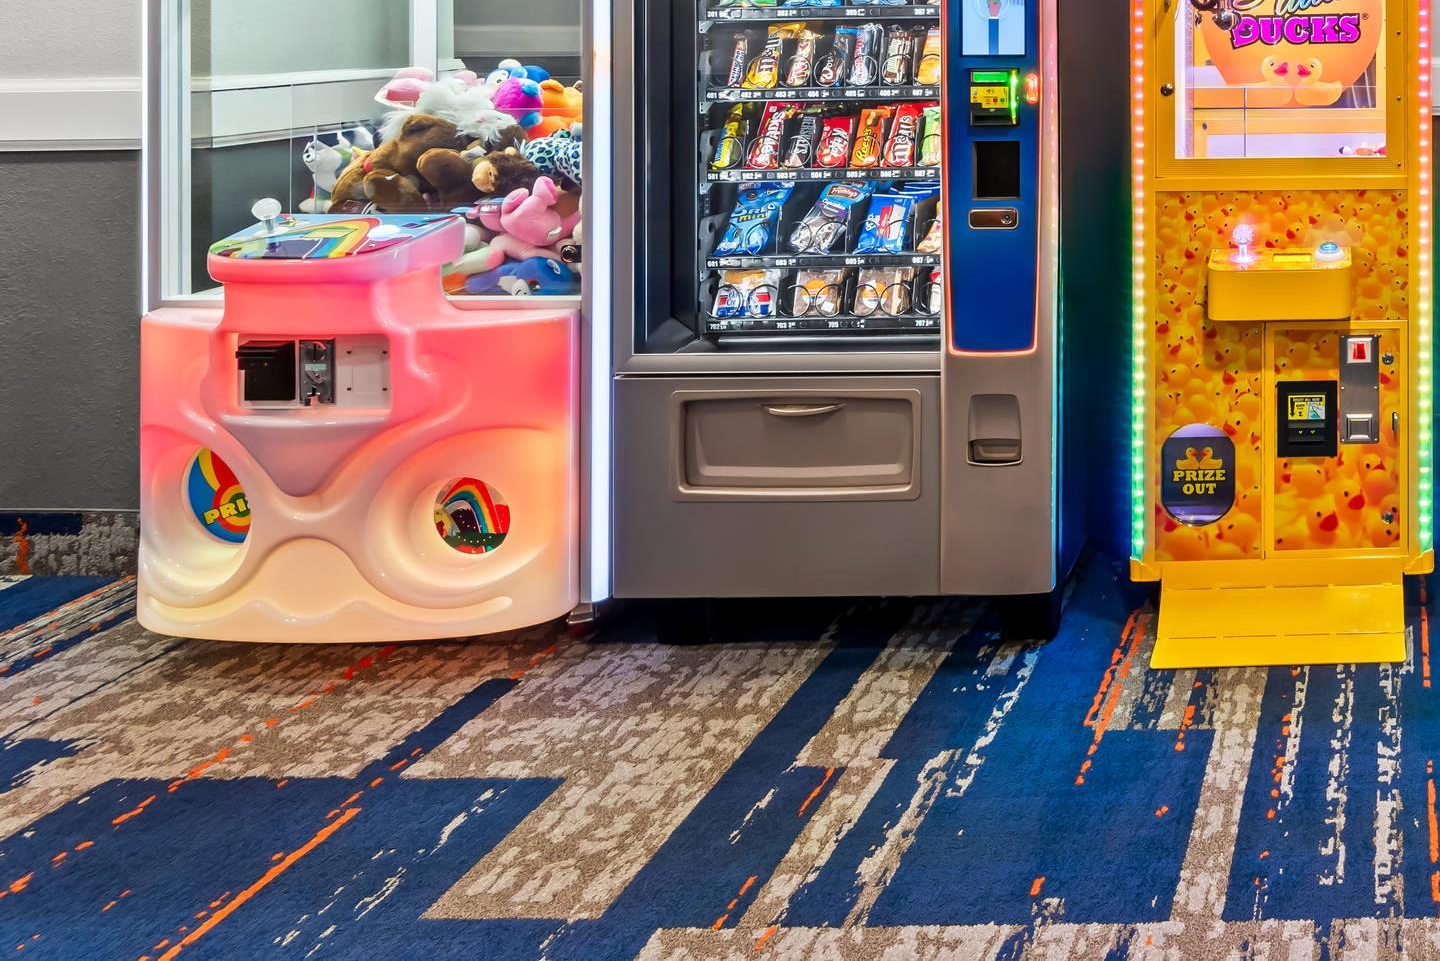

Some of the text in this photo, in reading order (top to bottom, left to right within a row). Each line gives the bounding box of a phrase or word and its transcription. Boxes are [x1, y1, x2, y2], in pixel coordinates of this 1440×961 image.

[1231, 12, 1361, 50] DUCKS
[1173, 469, 1226, 482] PRIZE
[1182, 483, 1217, 495] OUT
